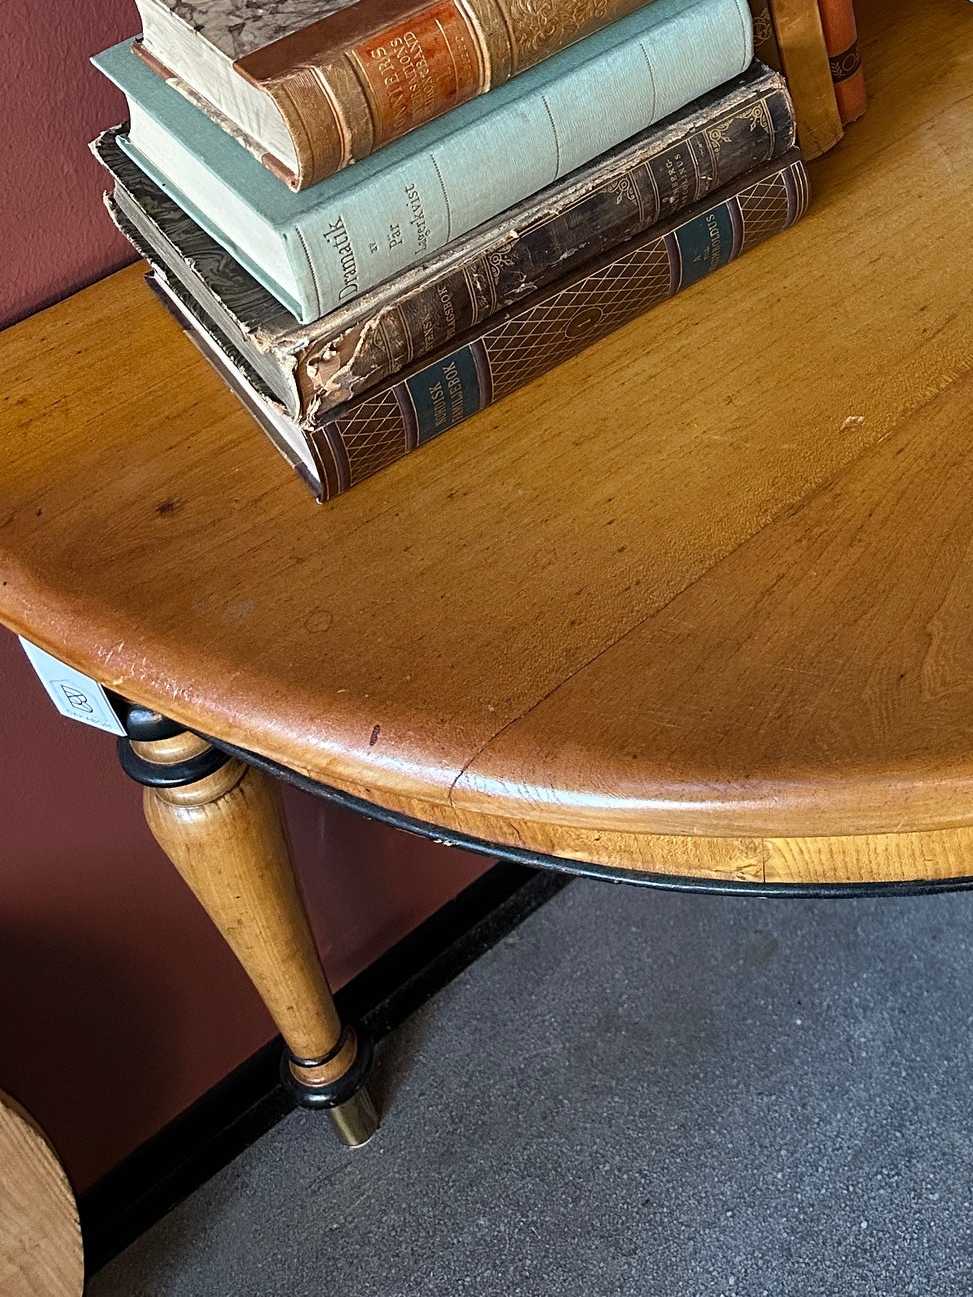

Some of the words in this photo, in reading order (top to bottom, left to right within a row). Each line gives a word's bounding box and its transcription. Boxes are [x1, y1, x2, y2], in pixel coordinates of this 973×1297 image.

[387, 223, 403, 250] Pär
[405, 183, 431, 255] Lagerkvist
[323, 215, 358, 300] Dramatik
[370, 240, 378, 254] av
[429, 382, 447, 427] NORDISK
[443, 361, 464, 423] FAMILJEBOK
